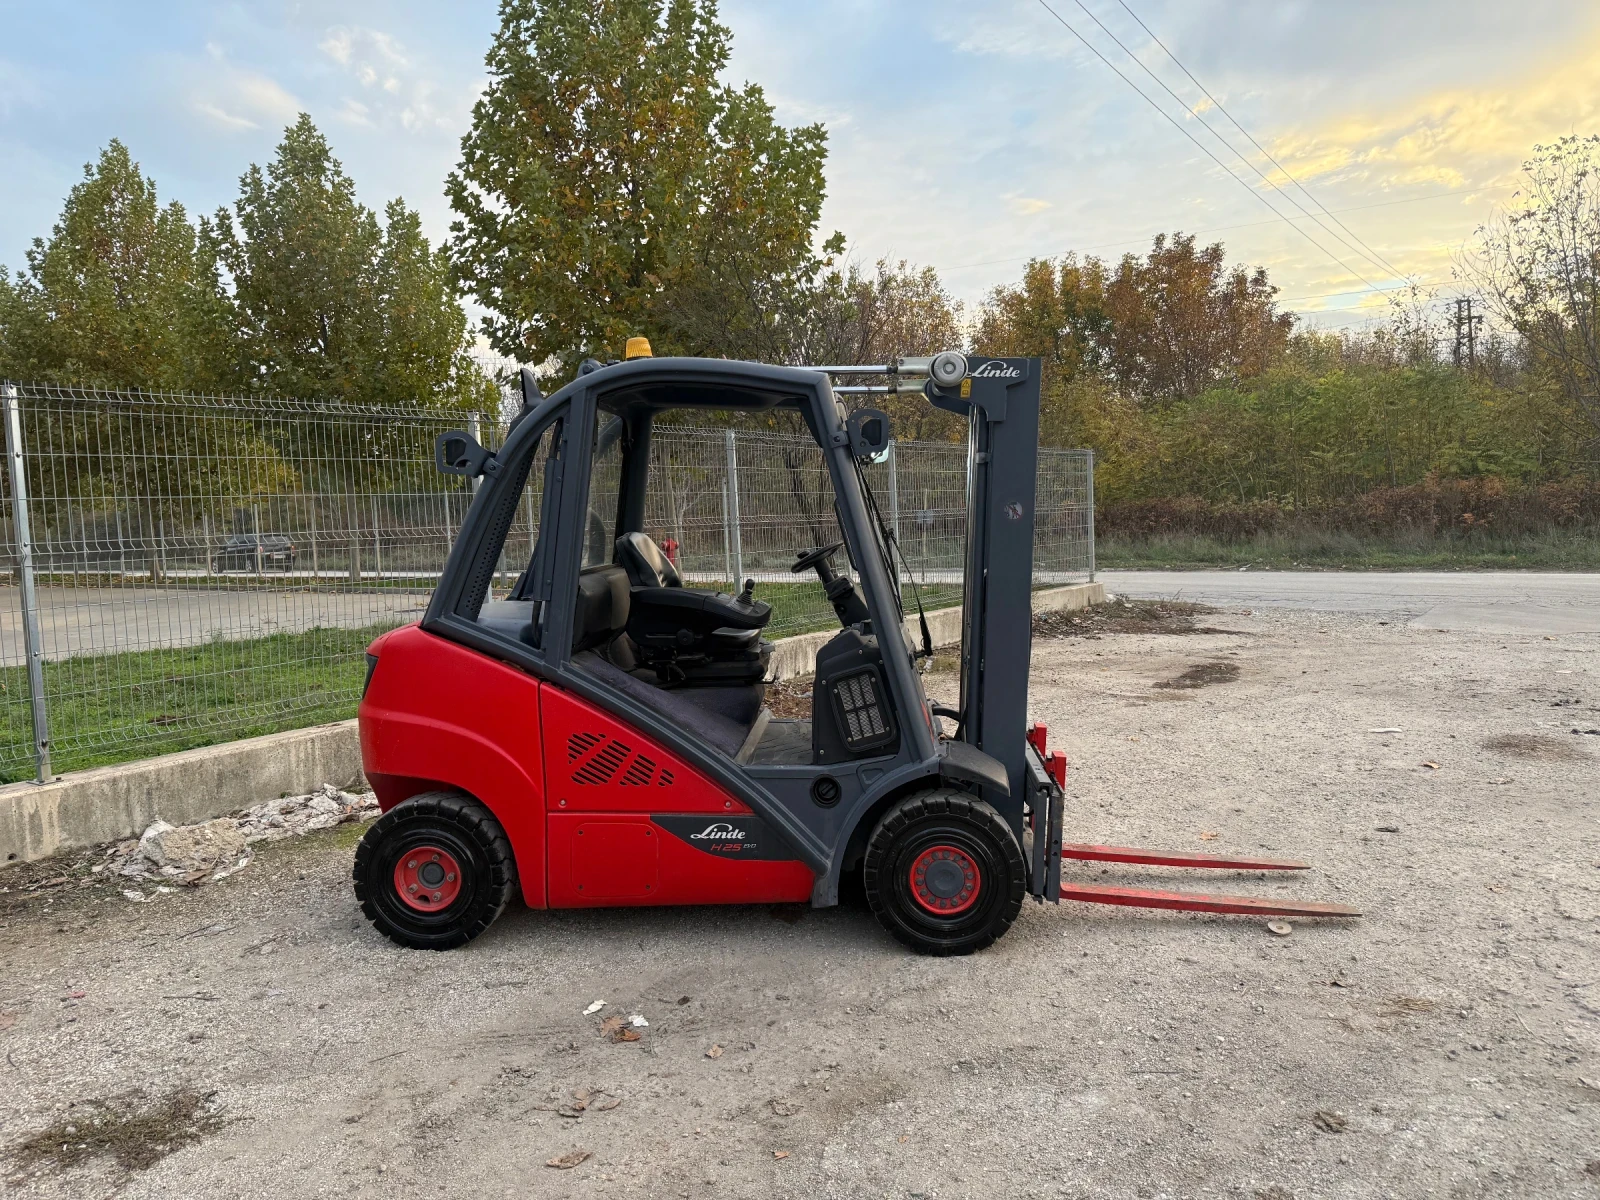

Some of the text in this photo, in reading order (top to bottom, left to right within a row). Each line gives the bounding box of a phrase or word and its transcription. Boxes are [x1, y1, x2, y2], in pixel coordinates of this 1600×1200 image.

[966, 360, 1020, 378] Linde
[690, 823, 746, 839] Linde
[710, 843, 723, 851] H
[722, 843, 743, 852] 25
